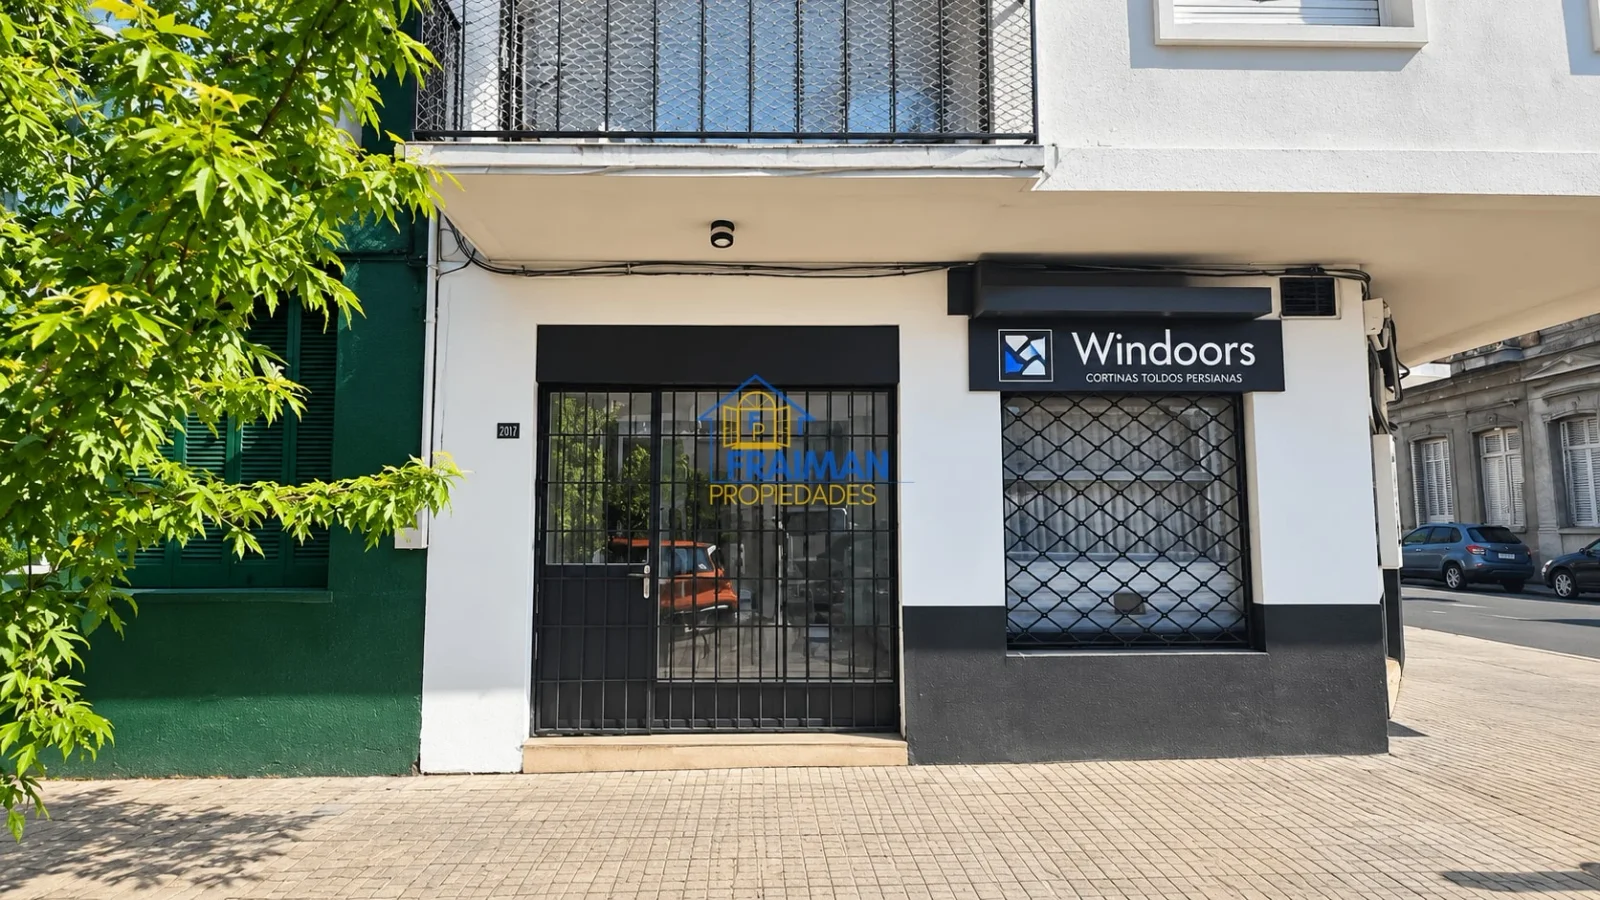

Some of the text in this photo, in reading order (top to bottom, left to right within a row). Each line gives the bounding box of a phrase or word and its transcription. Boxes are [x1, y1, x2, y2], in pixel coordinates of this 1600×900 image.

[1071, 329, 1256, 366] Windoors
[1085, 373, 1243, 383] CORTINAS TOLDOS PERSIANAS
[499, 425, 517, 437] 2017
